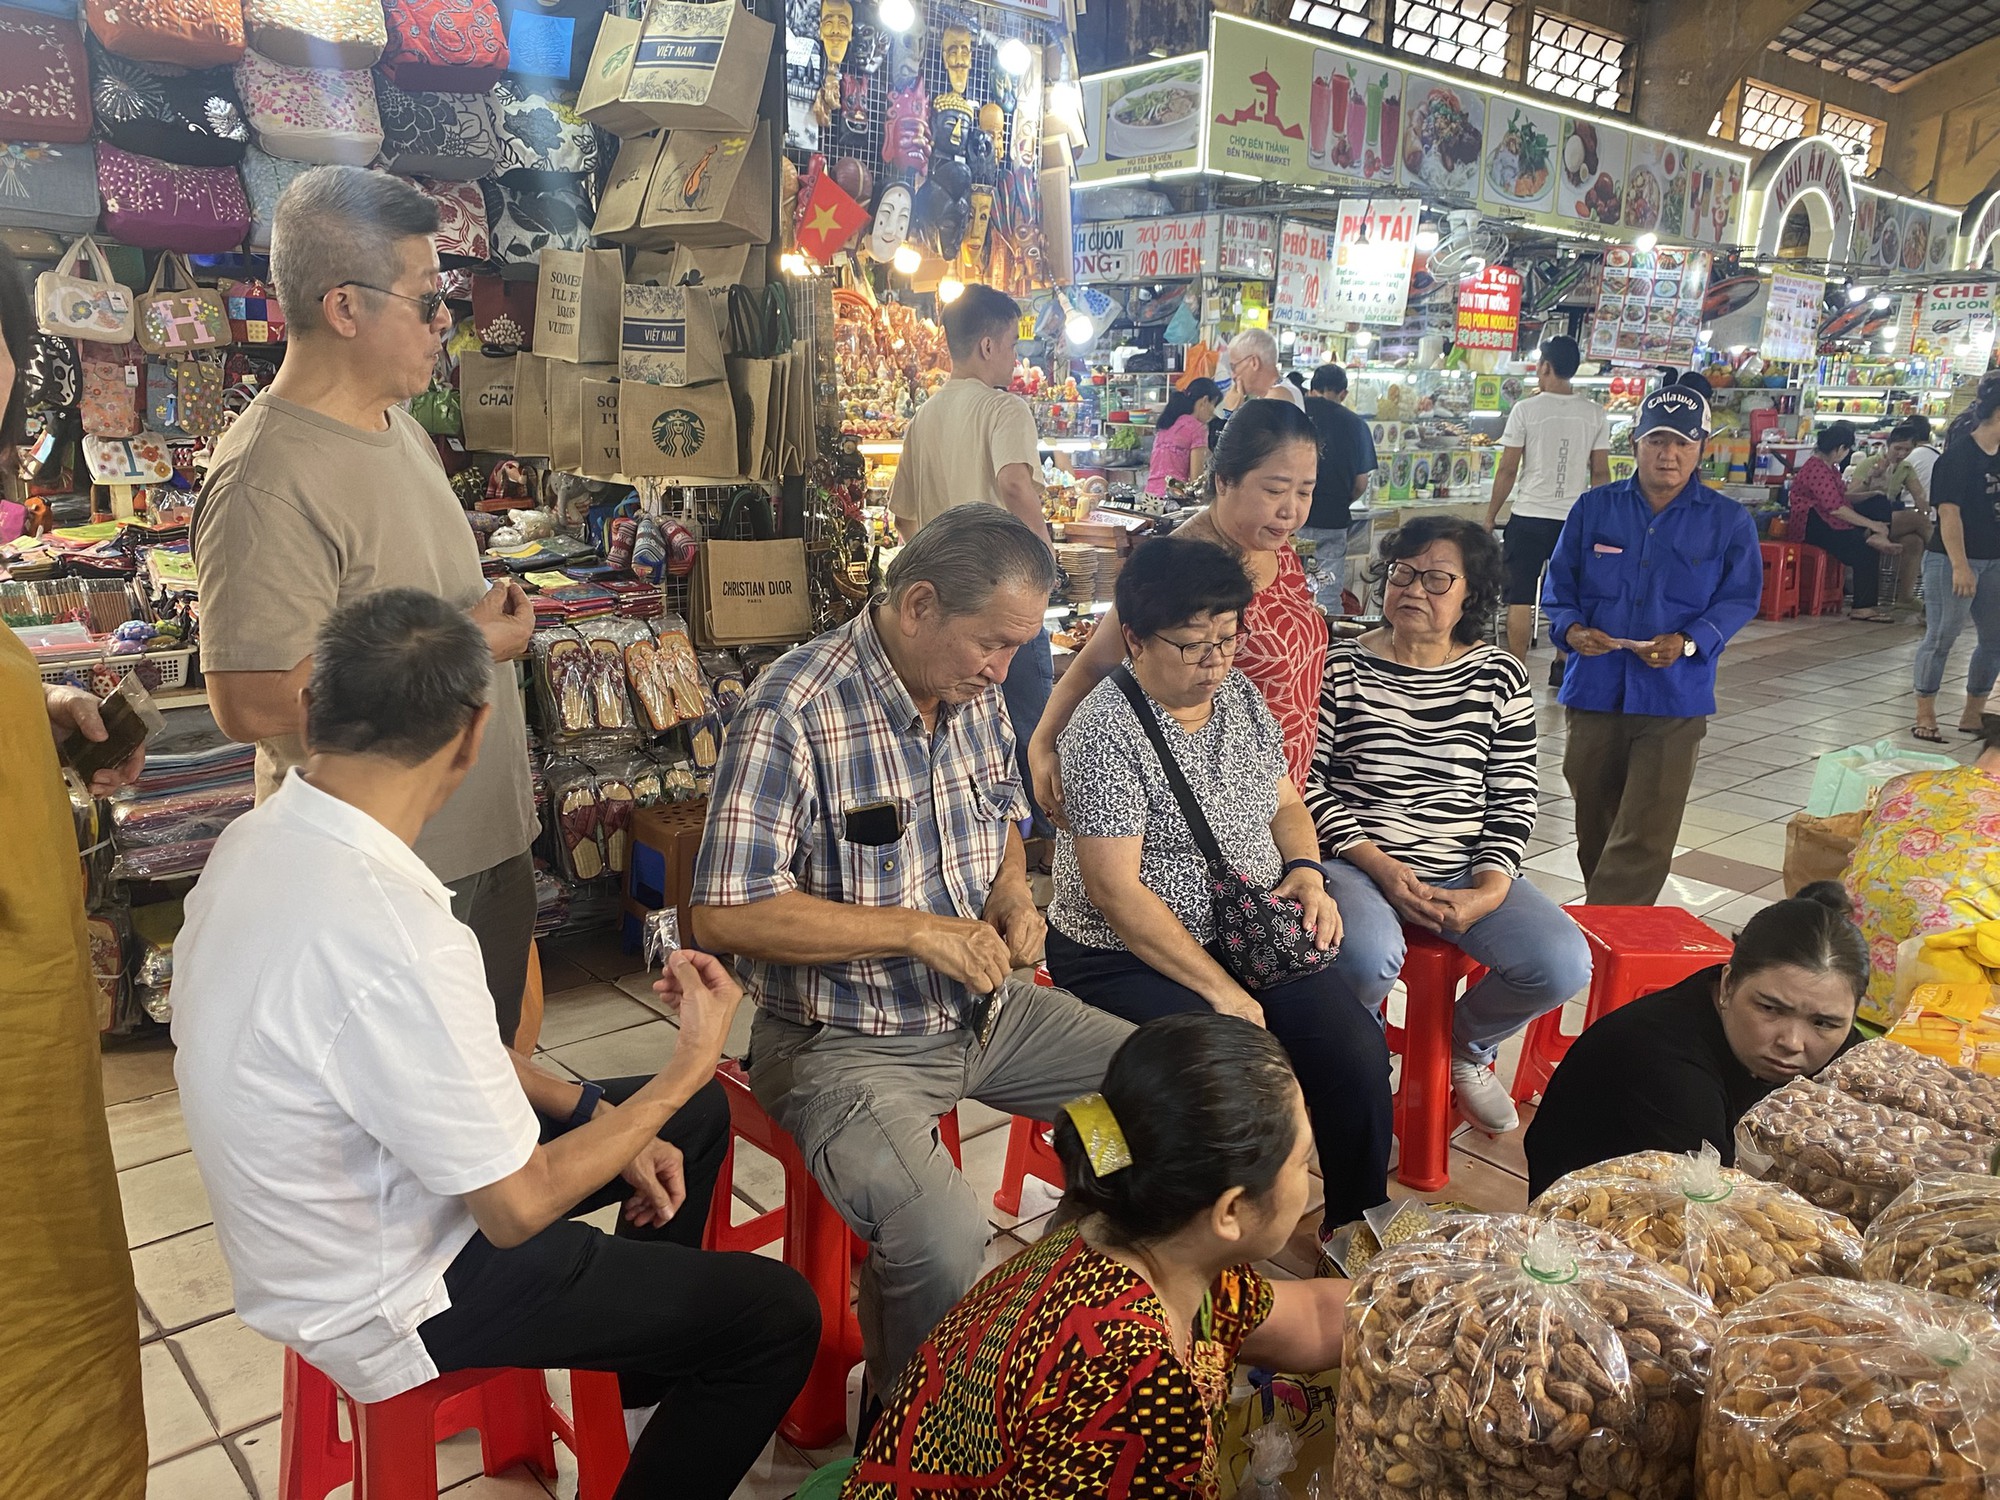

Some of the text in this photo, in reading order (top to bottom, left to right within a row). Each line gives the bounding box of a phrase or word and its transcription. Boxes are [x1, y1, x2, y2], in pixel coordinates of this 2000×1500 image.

[675, 45, 696, 58] NAM
[1229, 134, 1290, 155] CHỢ BẾN THÀNH
[1153, 160, 1183, 170] NOODLES
[1265, 154, 1291, 167] MARKET
[1775, 155, 1802, 213] KHU
[1807, 143, 1826, 182] ĂN
[1379, 206, 1413, 242] TÁI
[1088, 225, 1123, 251] CUỐN
[1283, 226, 1309, 257] PHỞ
[1162, 241, 1201, 276] VIÊN
[1489, 268, 1520, 285] Tám
[1458, 311, 1517, 331] BBQ PORK NOODLES
[645, 328, 677, 343] VIỆT NAM
[1647, 391, 1699, 410] Callaway
[1554, 438, 1569, 499] PORSCHE
[722, 580, 793, 597] CHRISTIAN DIOR
